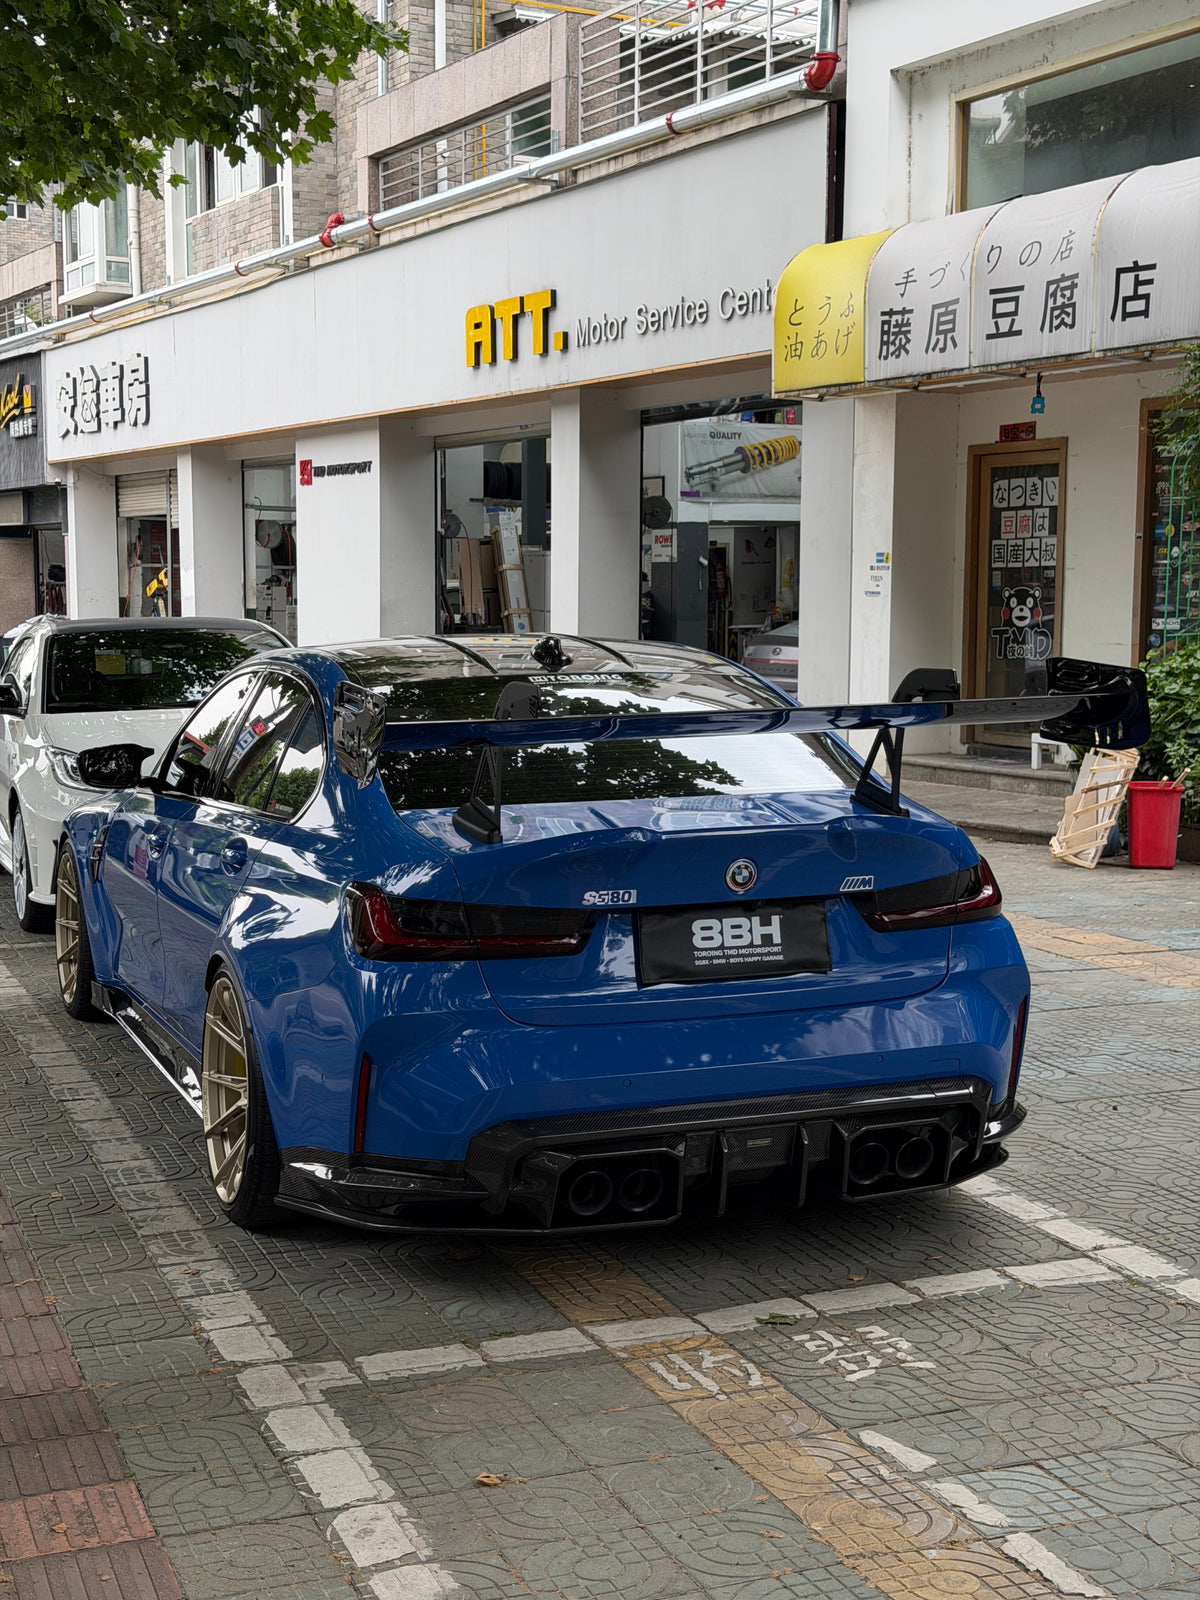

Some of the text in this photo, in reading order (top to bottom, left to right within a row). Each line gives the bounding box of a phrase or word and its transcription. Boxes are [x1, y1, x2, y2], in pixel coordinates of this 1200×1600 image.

[894, 229, 1077, 298] 手づくりの店
[575, 314, 627, 348] Motor
[635, 297, 709, 336] Service
[788, 291, 855, 327] とうふ
[878, 260, 1158, 361] 藤原豆腐店
[784, 321, 856, 362] 油あげ
[709, 431, 742, 440] QUALITY
[994, 480, 1057, 504] なつきい
[1002, 512, 1048, 535] 豆腐は
[991, 541, 1056, 565] 国産大叔
[991, 627, 1052, 661] TMD
[691, 914, 781, 949] 8BH
[693, 949, 723, 958] TOROING
[738, 946, 782, 955] MOTORSPORT
